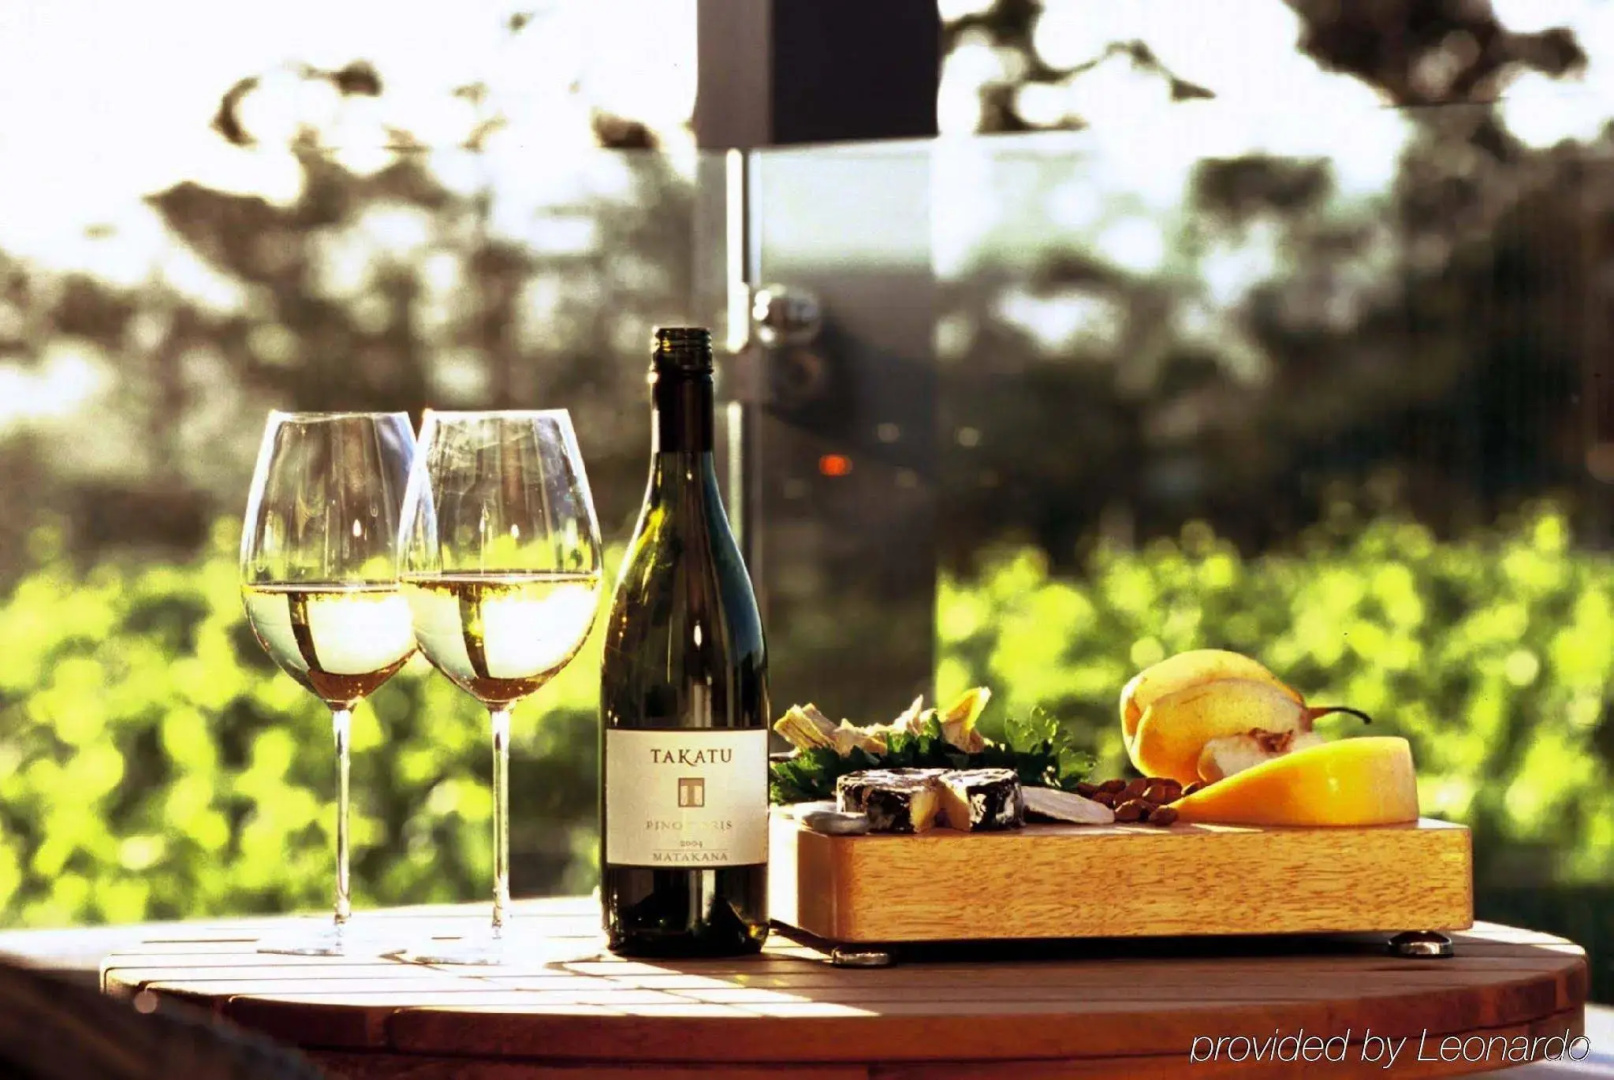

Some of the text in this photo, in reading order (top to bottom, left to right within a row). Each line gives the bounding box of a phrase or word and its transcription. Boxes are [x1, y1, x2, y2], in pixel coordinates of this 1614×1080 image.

[650, 748, 733, 767] TAKATU
[646, 820, 733, 831] PINO RIS
[680, 840, 704, 849] 2004
[653, 852, 729, 862] MATAKANA
